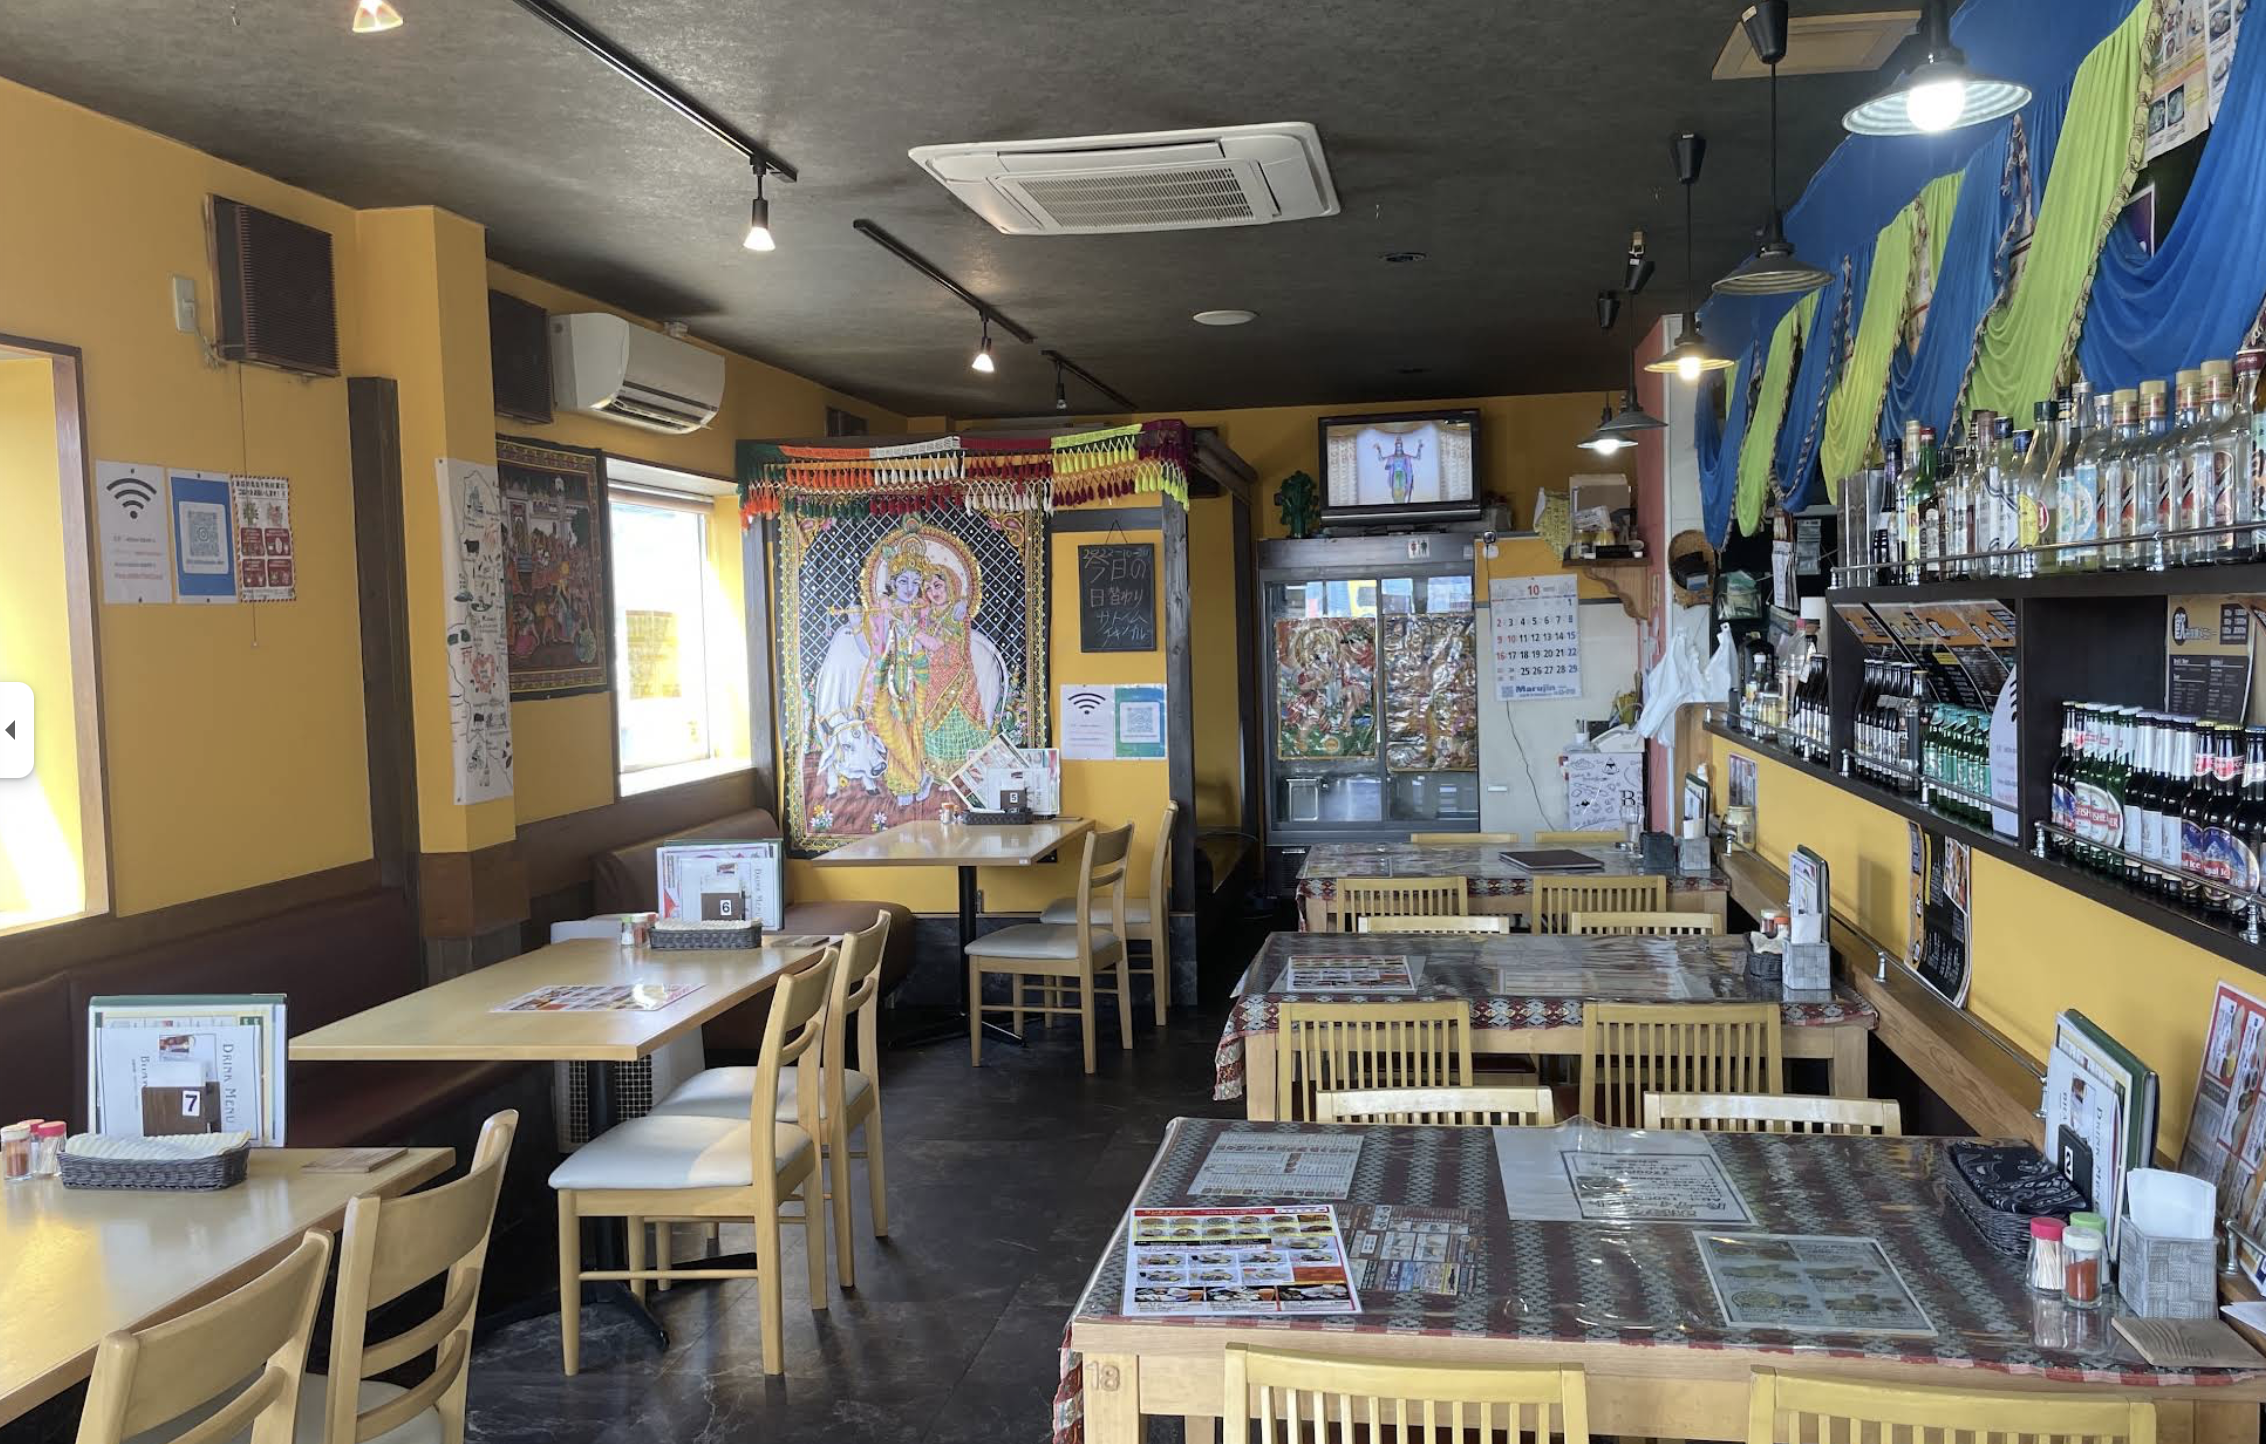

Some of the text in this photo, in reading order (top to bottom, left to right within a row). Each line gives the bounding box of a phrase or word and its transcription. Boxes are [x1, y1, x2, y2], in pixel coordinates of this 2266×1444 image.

[1528, 585, 1540, 596] 10
[1497, 619, 1502, 627] 2
[1509, 619, 1514, 627] 3
[1520, 618, 1525, 626] 4
[1532, 617, 1537, 625] 5
[1544, 616, 1549, 624] 6
[1497, 636, 1502, 644] 9
[1507, 635, 1516, 643] 10
[1520, 634, 1528, 642] 11
[1543, 633, 1551, 641] 13
[1555, 632, 1564, 640] 14
[1567, 631, 1576, 639] 15
[1497, 652, 1505, 660] 16
[1520, 651, 1528, 659] 18
[1544, 650, 1553, 658] 20
[1556, 649, 1564, 657] 21
[1567, 648, 1576, 656] 22
[1521, 667, 1530, 675] 25
[1532, 667, 1542, 675] 26
[1544, 666, 1553, 674] 27
[1556, 665, 1565, 674] 28
[1568, 664, 1577, 673] 29
[1619, 790, 1635, 806] B
[722, 901, 730, 913] 6
[222, 1043, 237, 1124] DRINK MENU
[184, 1094, 198, 1112] 7
[2066, 1152, 2072, 1176] 2
